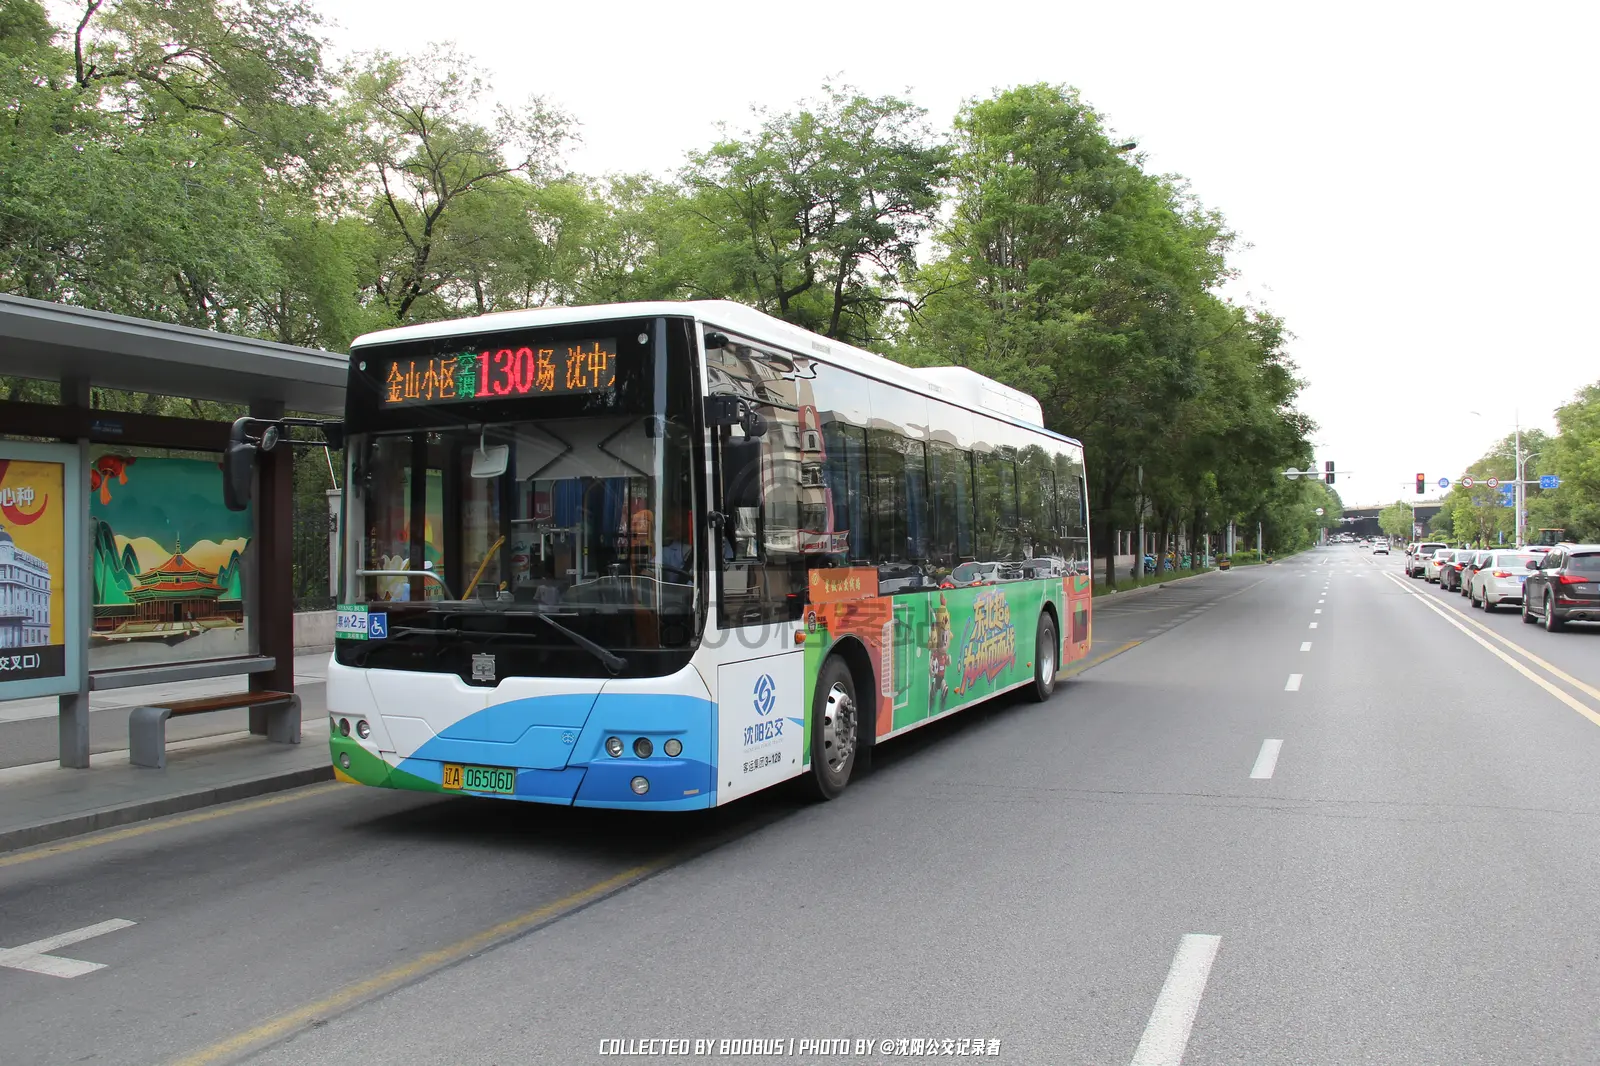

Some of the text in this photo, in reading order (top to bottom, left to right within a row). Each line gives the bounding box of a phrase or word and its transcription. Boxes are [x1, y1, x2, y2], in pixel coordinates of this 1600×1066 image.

[385, 357, 457, 402] 金山小区
[457, 351, 477, 398] 空调
[475, 347, 535, 397] 130
[743, 717, 784, 746] 沈阳公交
